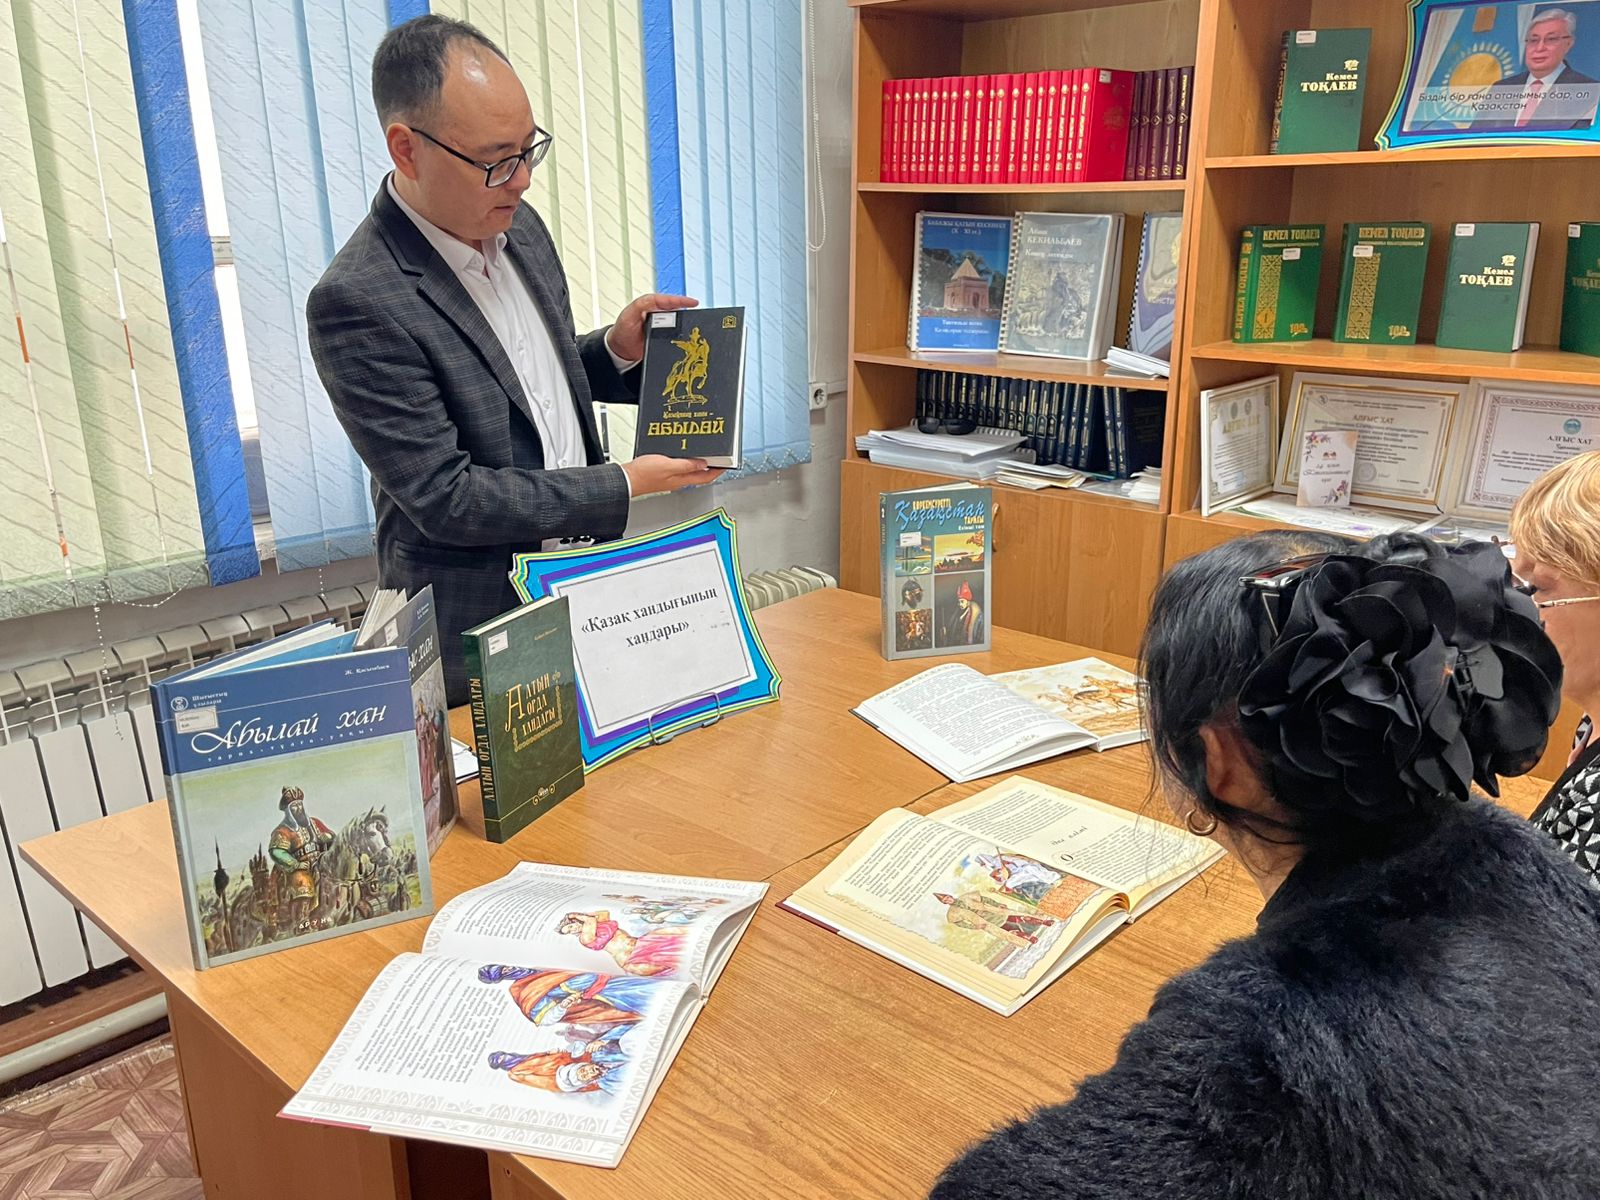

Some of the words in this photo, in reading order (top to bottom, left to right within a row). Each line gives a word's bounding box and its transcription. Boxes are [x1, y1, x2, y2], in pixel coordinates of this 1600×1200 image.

[1326, 72, 1358, 80] Кемел
[1300, 81, 1357, 93] ТОҚАЕВ
[1418, 92, 1447, 101] Біздің
[1449, 91, 1465, 101] бір
[1467, 92, 1491, 100] ғана
[1494, 92, 1546, 100] отанымыз
[1549, 90, 1573, 100] бар,
[1471, 102, 1527, 111] Қазақстан
[1483, 267, 1514, 276] Кемел
[1459, 275, 1514, 287] ТОҚАЕВ
[648, 417, 725, 436] АБЫЛАЙ
[681, 439, 687, 450] 1
[581, 611, 632, 634] «Қазақ
[632, 588, 718, 620] хандығының
[626, 621, 690, 648] хандары»
[191, 712, 320, 754] Абылай
[335, 705, 387, 730] хан
